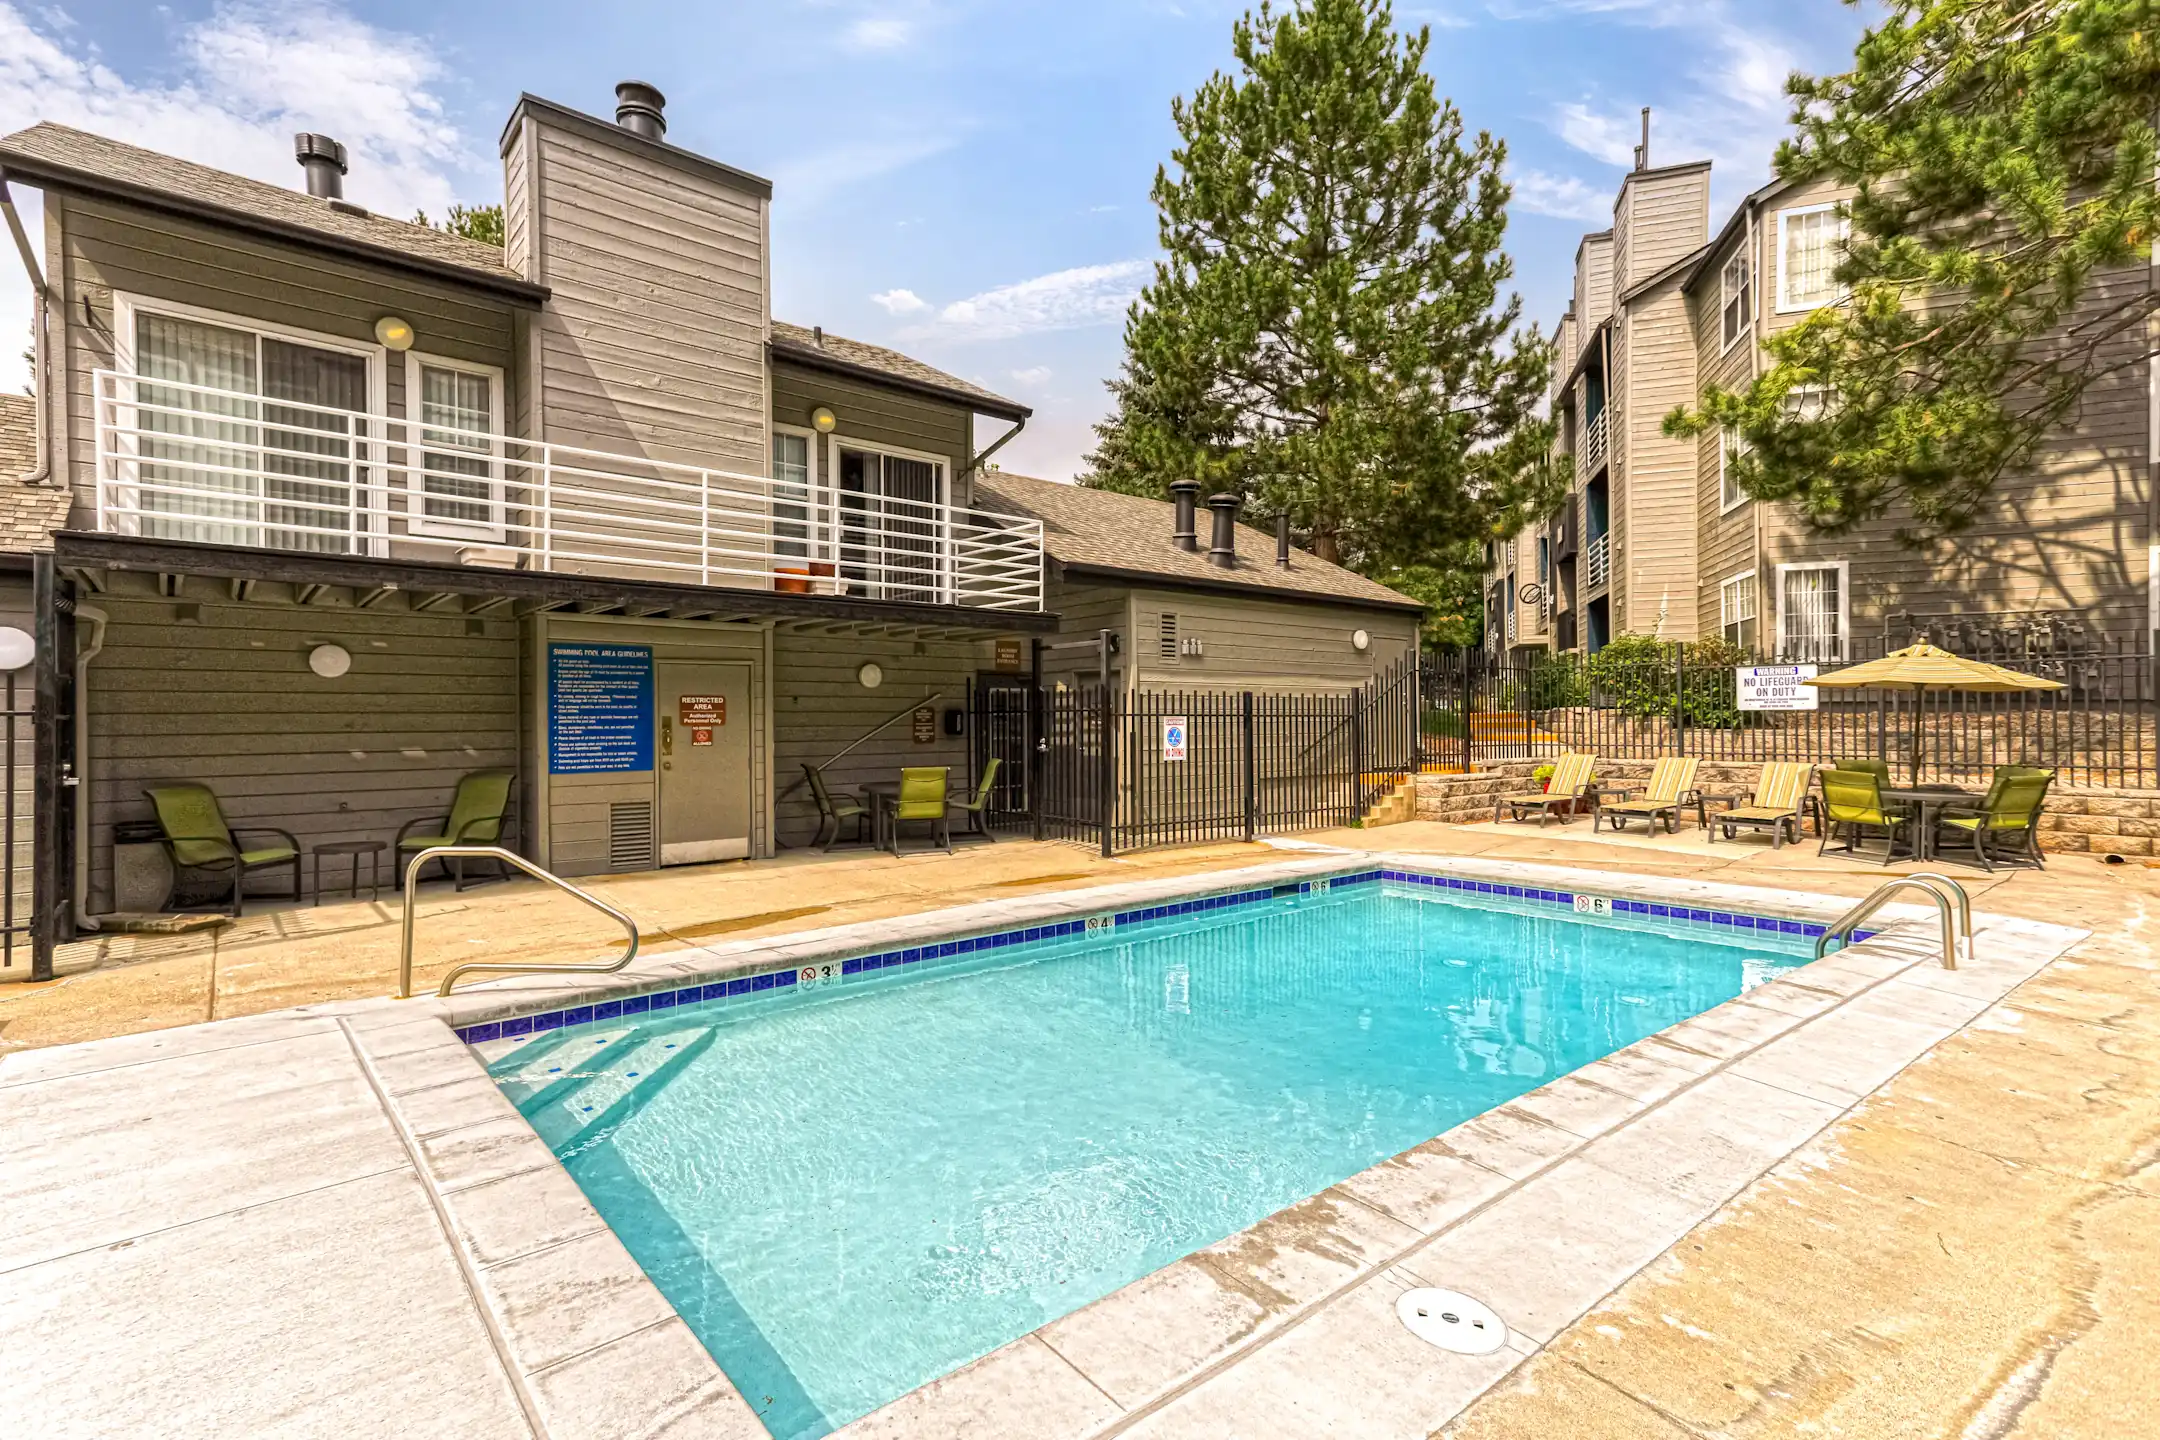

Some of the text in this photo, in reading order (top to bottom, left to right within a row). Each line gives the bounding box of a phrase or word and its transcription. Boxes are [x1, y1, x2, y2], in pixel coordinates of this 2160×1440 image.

[553, 648, 583, 656] SWIMMING
[584, 649, 599, 657] POOL
[617, 650, 648, 658] GUIDELINES
[1757, 667, 1796, 676] WARNING
[1743, 677, 1756, 687] NO
[1756, 687, 1797, 697] ON DUTY
